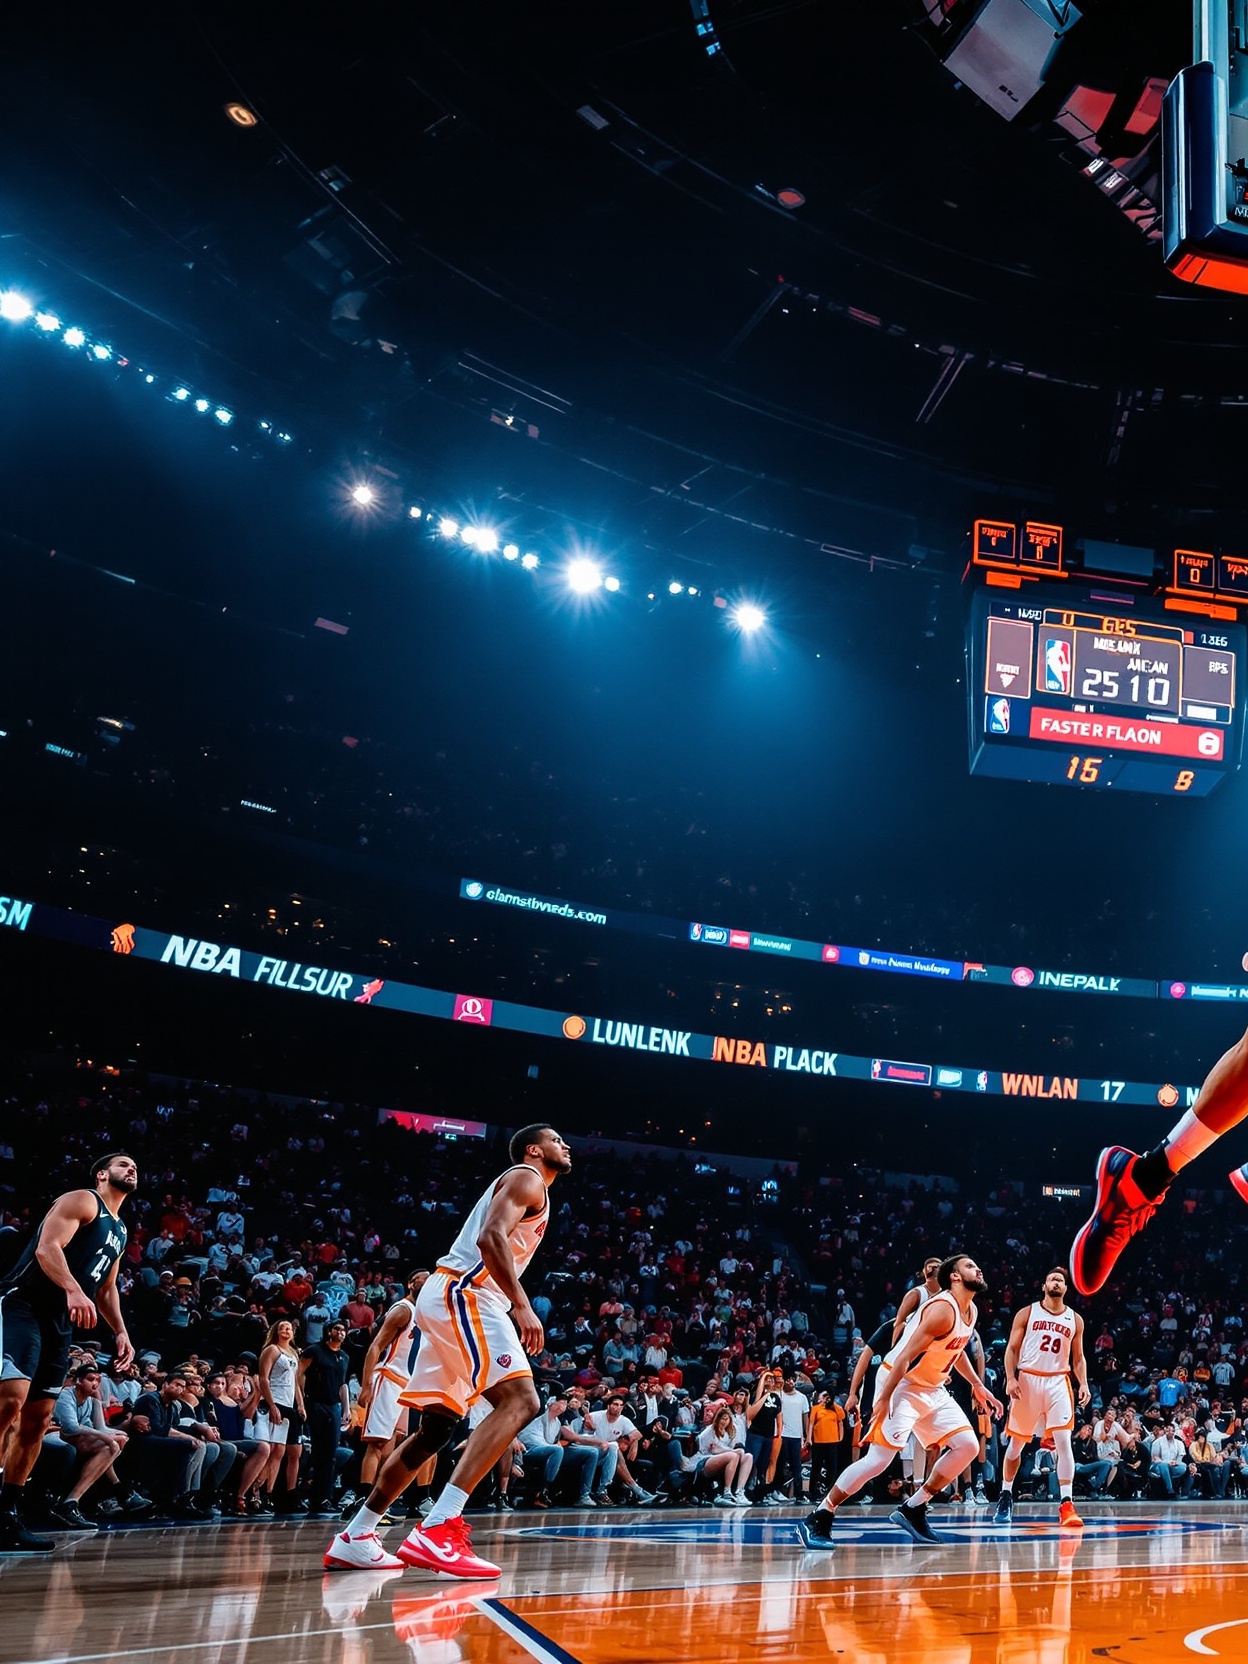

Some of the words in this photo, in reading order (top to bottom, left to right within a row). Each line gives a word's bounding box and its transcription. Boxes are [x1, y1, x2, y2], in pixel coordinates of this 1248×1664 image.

[160, 934, 242, 978] NBA
[773, 1045, 838, 1076] PLACK
[1100, 1080, 1126, 1102] 17
